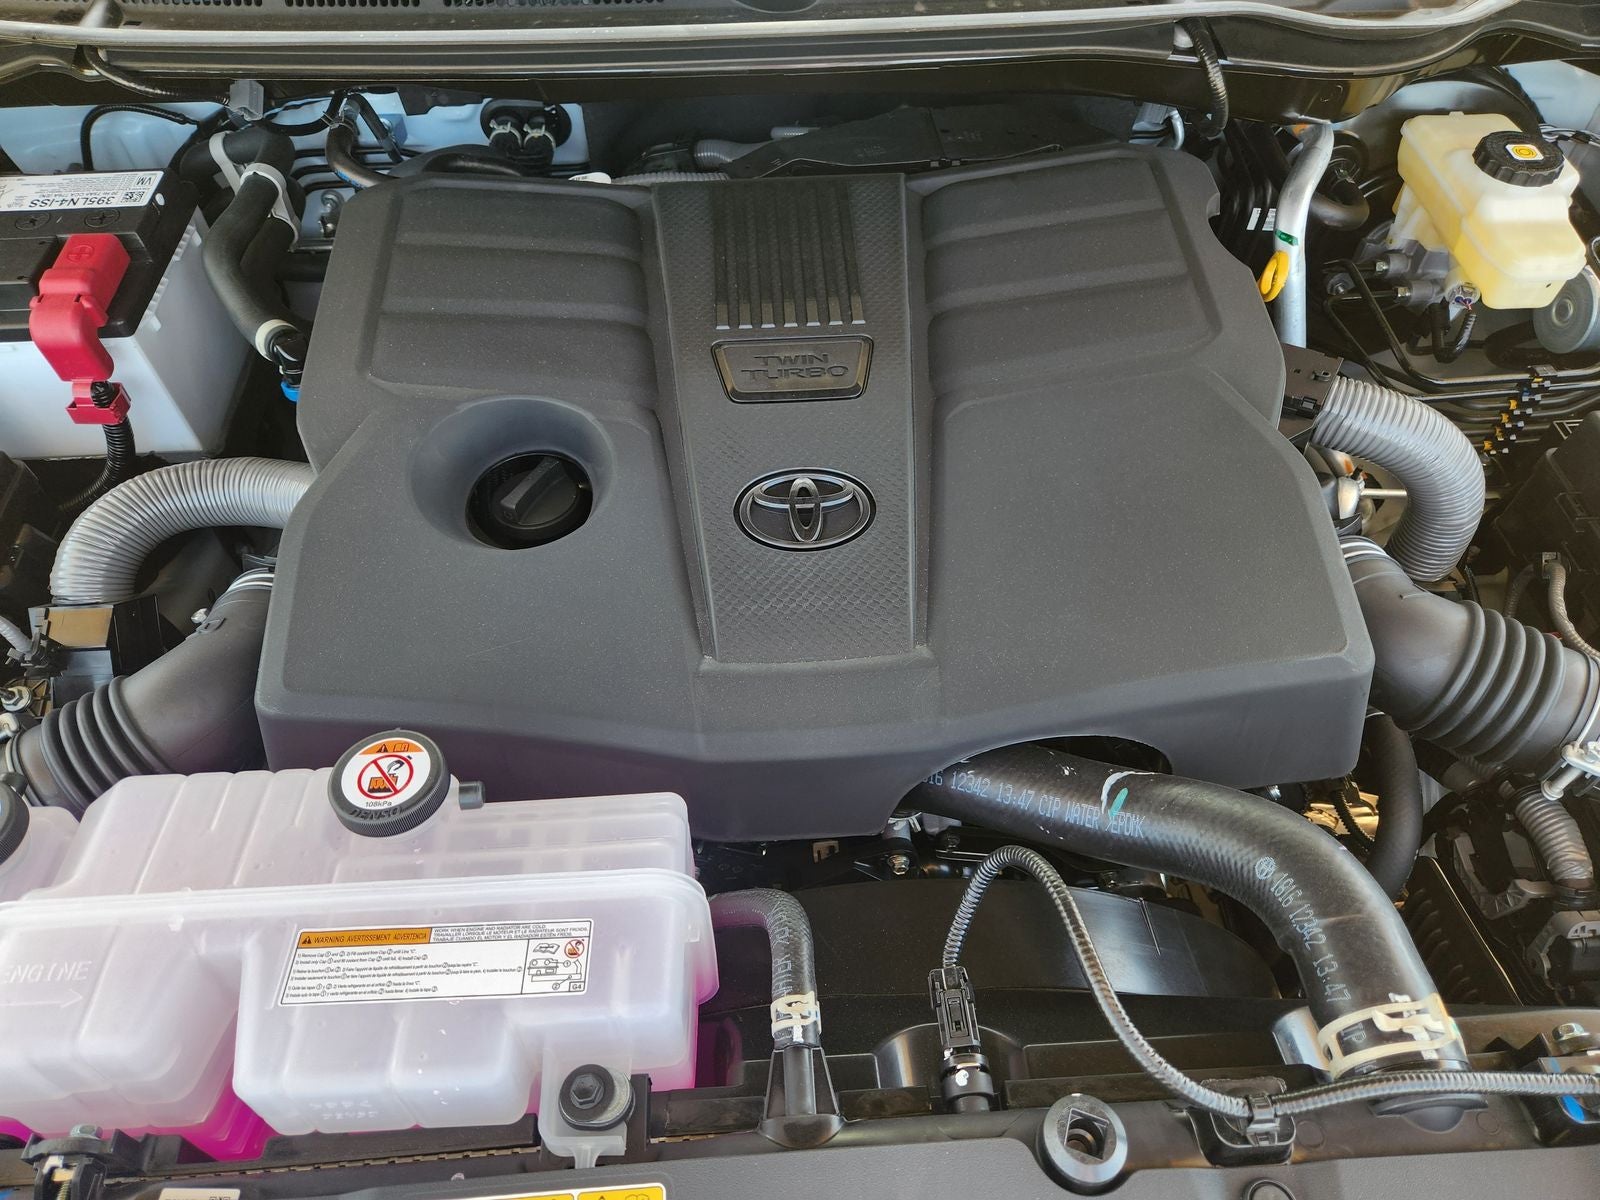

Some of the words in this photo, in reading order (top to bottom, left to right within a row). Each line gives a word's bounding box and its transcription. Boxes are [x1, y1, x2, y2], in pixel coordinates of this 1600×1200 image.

[136, 176, 152, 186] VM
[29, 196, 115, 207] 395LN4-ISS
[753, 353, 829, 366] TWIN
[741, 365, 849, 381] TURBO
[951, 771, 991, 798] 12342
[996, 783, 1035, 811] 13:47
[1038, 794, 1061, 818] CIP
[1064, 801, 1101, 830] WATER
[1288, 903, 1327, 951] 12342
[314, 935, 345, 944] WARNING
[347, 933, 390, 943] AVERTISSEMENT
[393, 932, 427, 941] ADVERTENCIA
